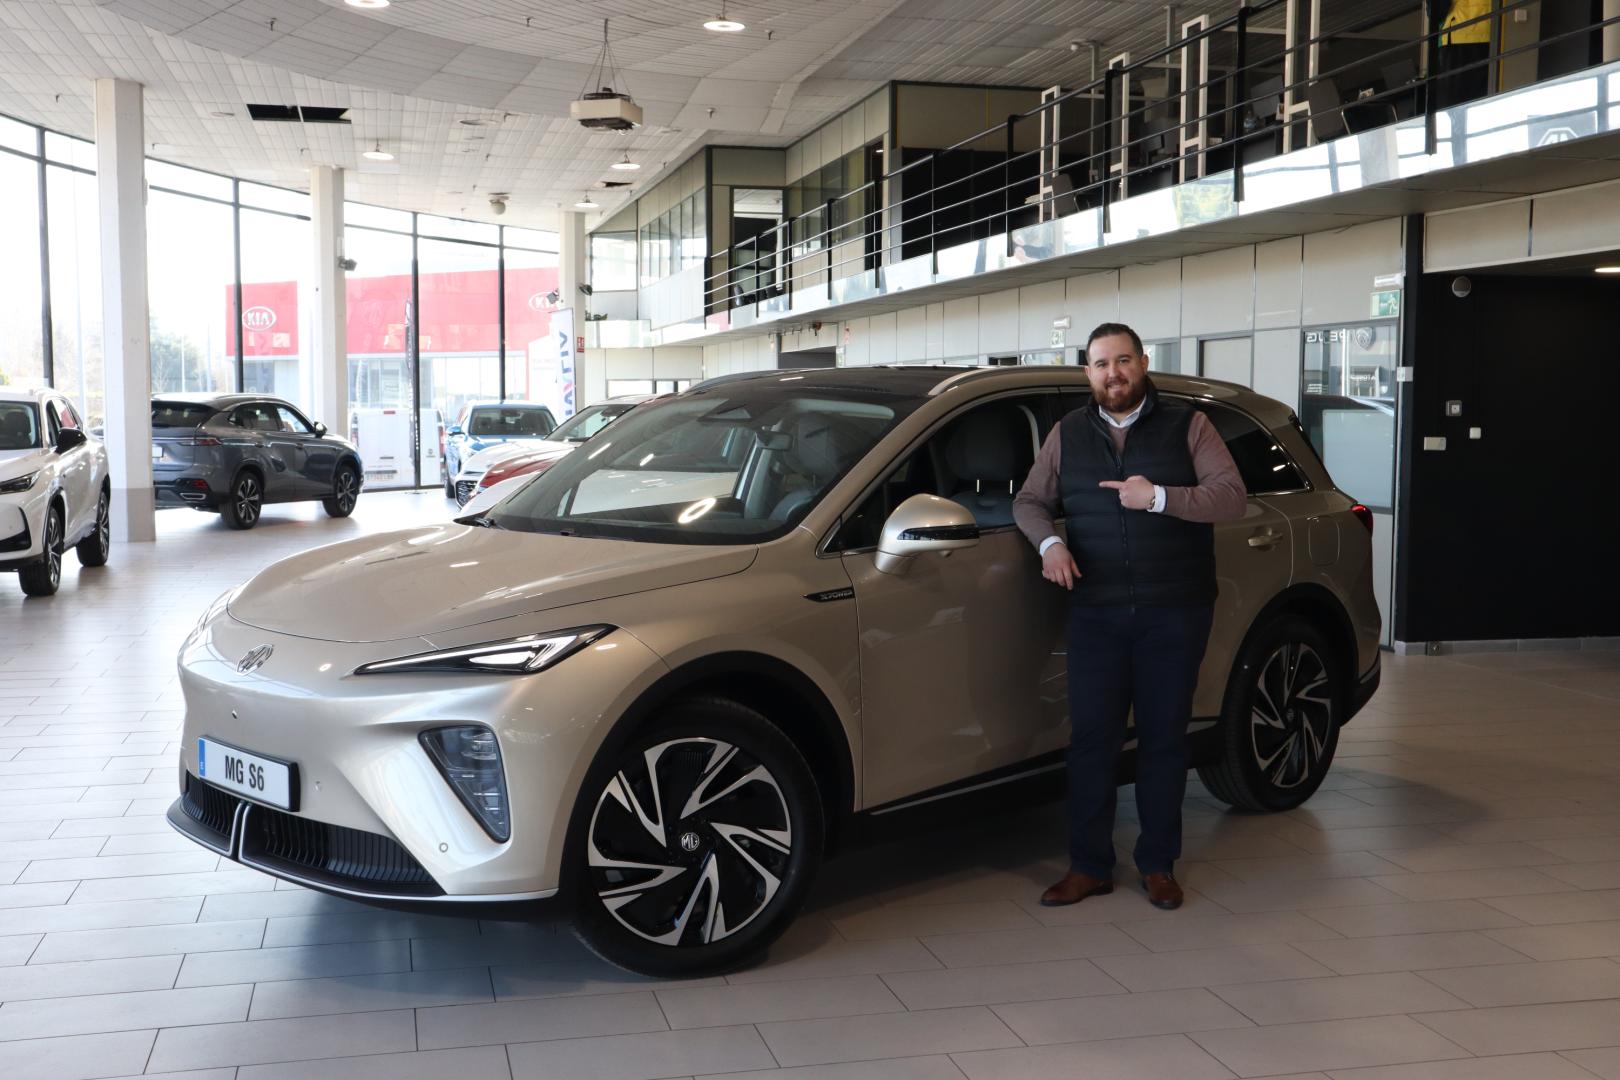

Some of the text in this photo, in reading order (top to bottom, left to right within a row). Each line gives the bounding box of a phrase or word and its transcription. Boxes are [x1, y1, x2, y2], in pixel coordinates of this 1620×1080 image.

[247, 312, 271, 326] KIA
[225, 755, 265, 792] MG S6
[682, 833, 699, 850] MG
